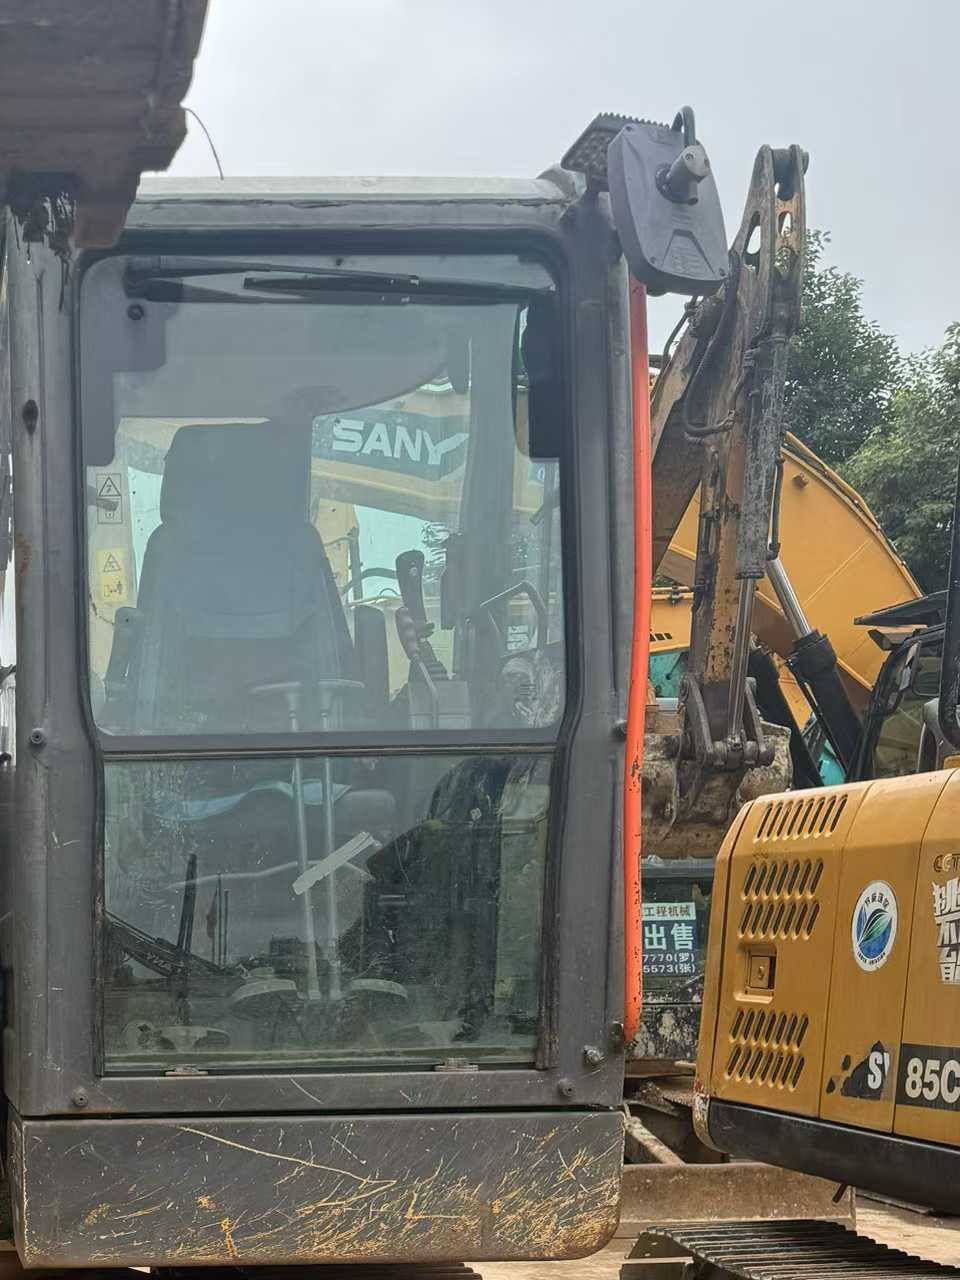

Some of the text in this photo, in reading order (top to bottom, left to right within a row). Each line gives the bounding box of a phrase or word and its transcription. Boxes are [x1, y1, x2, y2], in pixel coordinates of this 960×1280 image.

[332, 418, 469, 465] SANY
[643, 905, 692, 917] 工程机械
[644, 923, 694, 950] 出售
[905, 1057, 960, 1104] 85C
